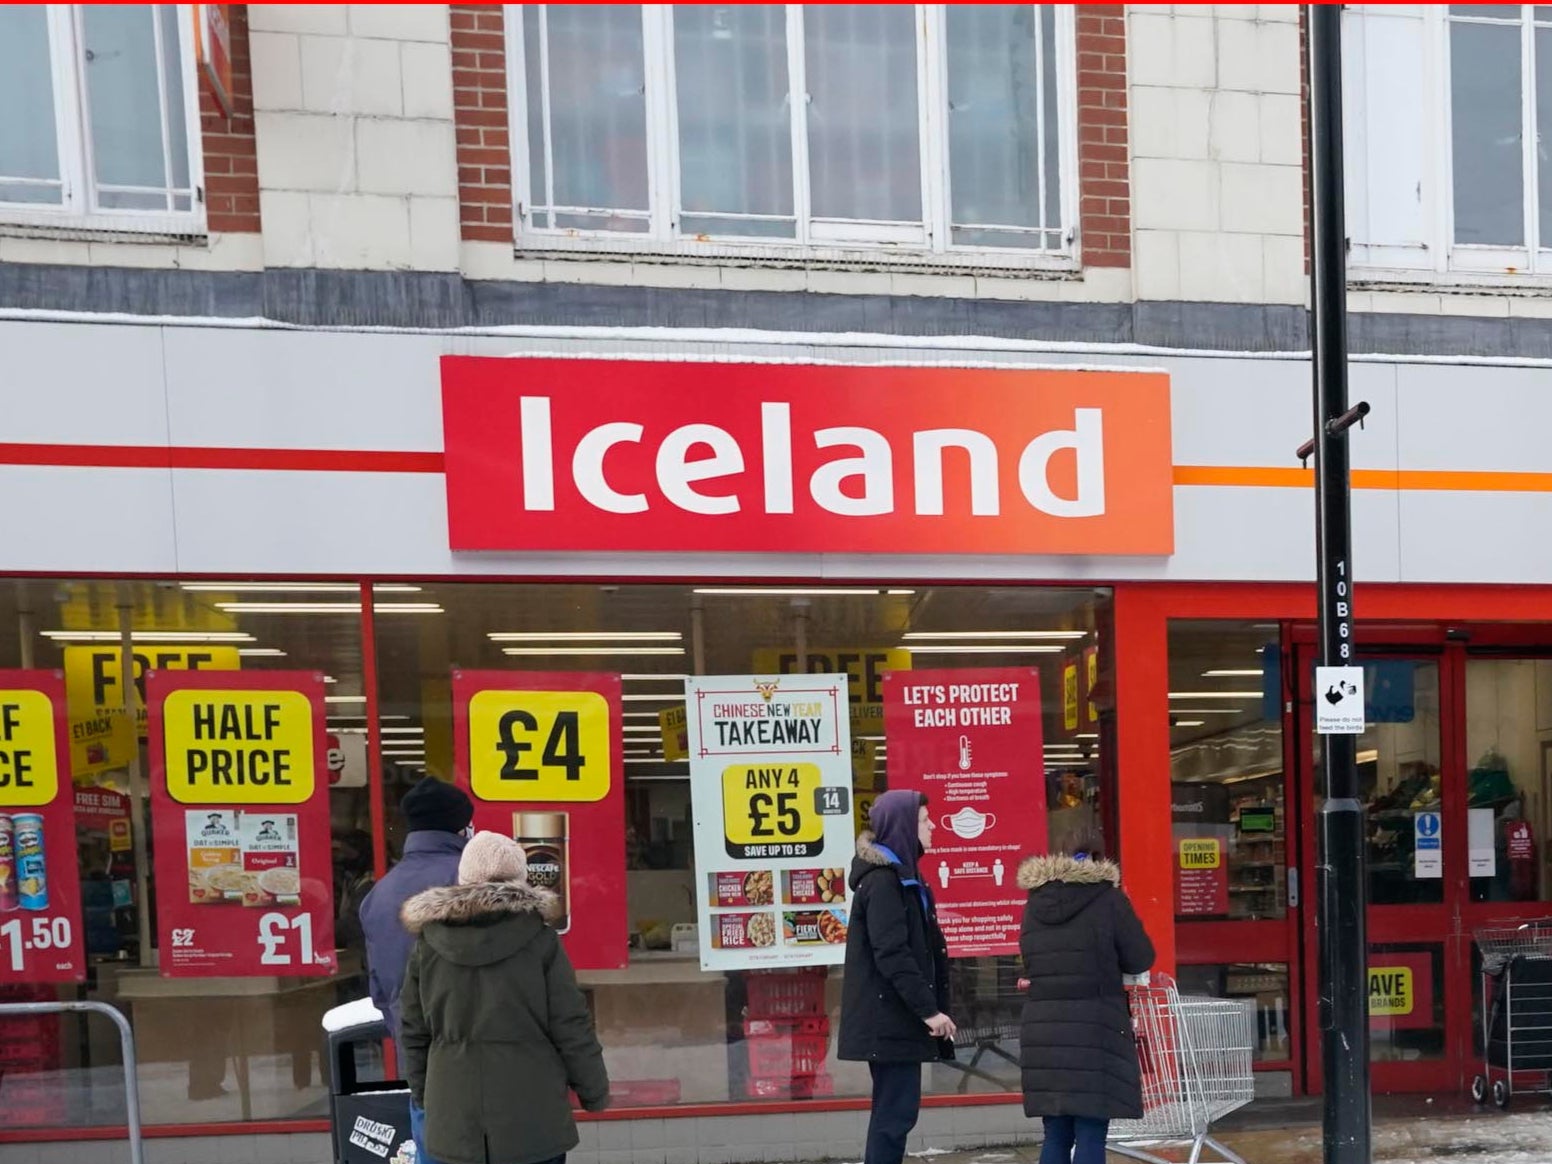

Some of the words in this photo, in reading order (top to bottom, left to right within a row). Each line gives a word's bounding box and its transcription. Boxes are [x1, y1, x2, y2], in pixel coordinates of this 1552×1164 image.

[520, 396, 1106, 517] Iceland
[1336, 560, 1350, 668] 10B68
[903, 685, 946, 705] LET'S
[949, 683, 1019, 703] PROTECT
[713, 703, 765, 718] CHINESE
[767, 703, 791, 717] NEW
[792, 702, 823, 717] YEAR
[914, 708, 956, 727] EACH
[960, 706, 1012, 726] OTHER
[87, 717, 112, 735] BACK
[193, 703, 280, 740] HALF
[714, 719, 821, 746] TAKEAWAY
[496, 710, 585, 781] £4
[187, 749, 291, 785] PRICE
[746, 769, 782, 789] ANY
[788, 768, 799, 788] 4
[76, 792, 99, 805] FREE
[101, 794, 121, 807] SIM
[823, 793, 840, 808] 14
[748, 793, 801, 837] £5
[744, 845, 767, 856] SAVE
[768, 845, 781, 856] UP
[781, 845, 793, 855] TO
[794, 844, 807, 855] £3
[1183, 843, 1215, 851] OPENING
[1184, 853, 1216, 865] TIMES
[172, 928, 195, 947] £2
[257, 912, 313, 965] £1
[796, 924, 817, 934] FIERY
[0, 917, 71, 971] 1.50
[1370, 973, 1405, 996] AVE
[1371, 997, 1406, 1008] BRANDS
